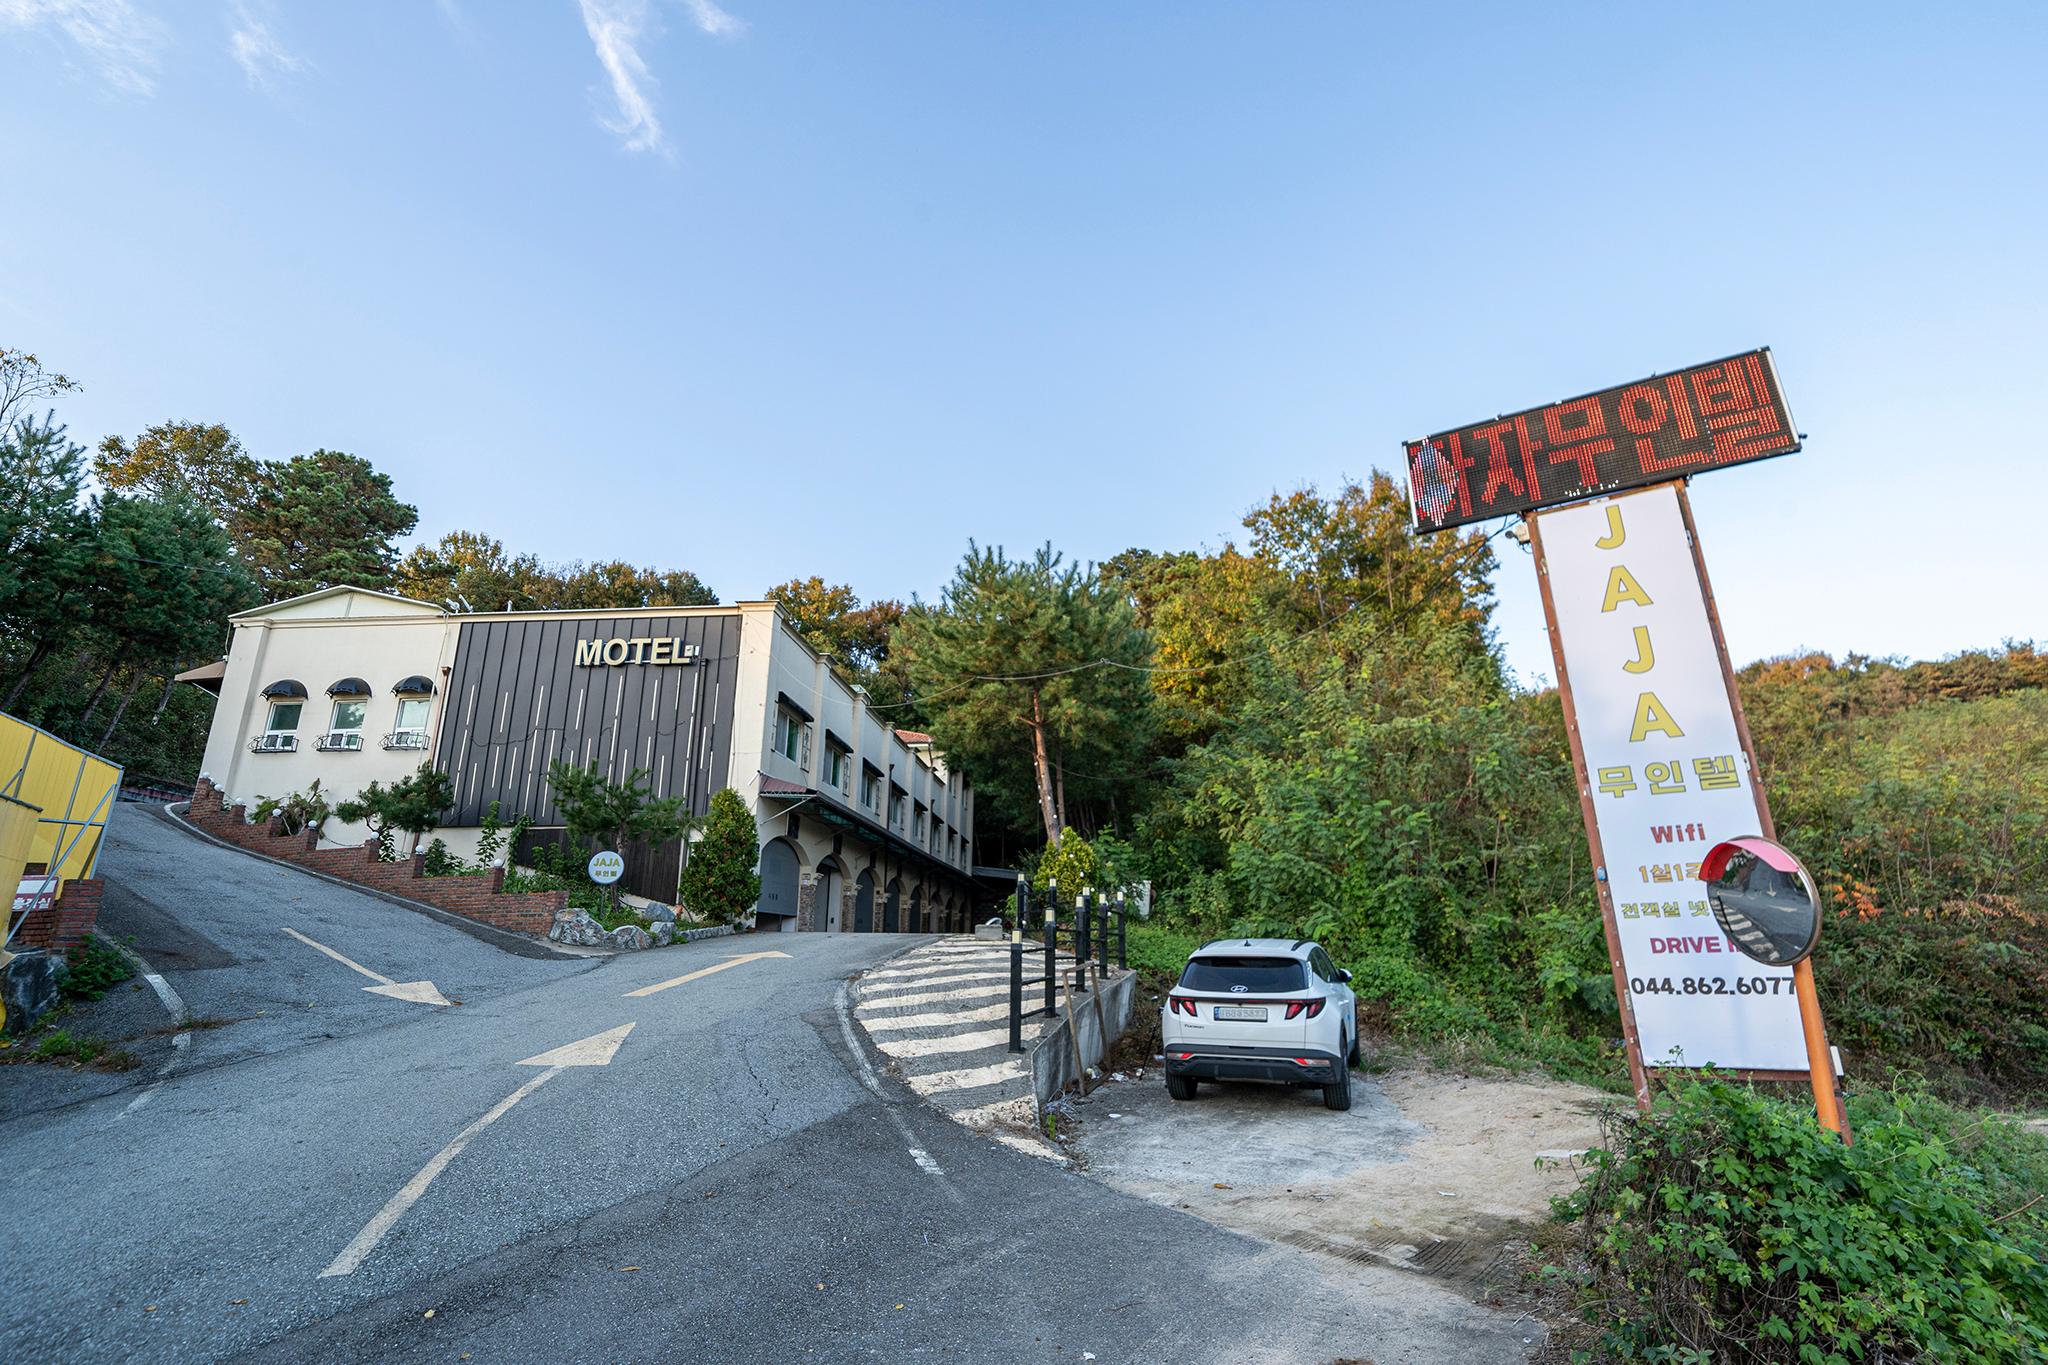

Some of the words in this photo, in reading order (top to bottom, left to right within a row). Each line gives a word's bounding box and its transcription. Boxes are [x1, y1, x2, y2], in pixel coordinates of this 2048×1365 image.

[575, 637, 691, 667] MOTEL
[1598, 755, 1741, 798] 무인텔
[1650, 823, 1707, 844] Wifi
[594, 858, 620, 867] JAJA
[1621, 901, 1681, 919] 전객실
[1650, 936, 1722, 954] DRIVE
[1727, 936, 1742, 954] I
[1630, 976, 1797, 995] 044.862.6077
